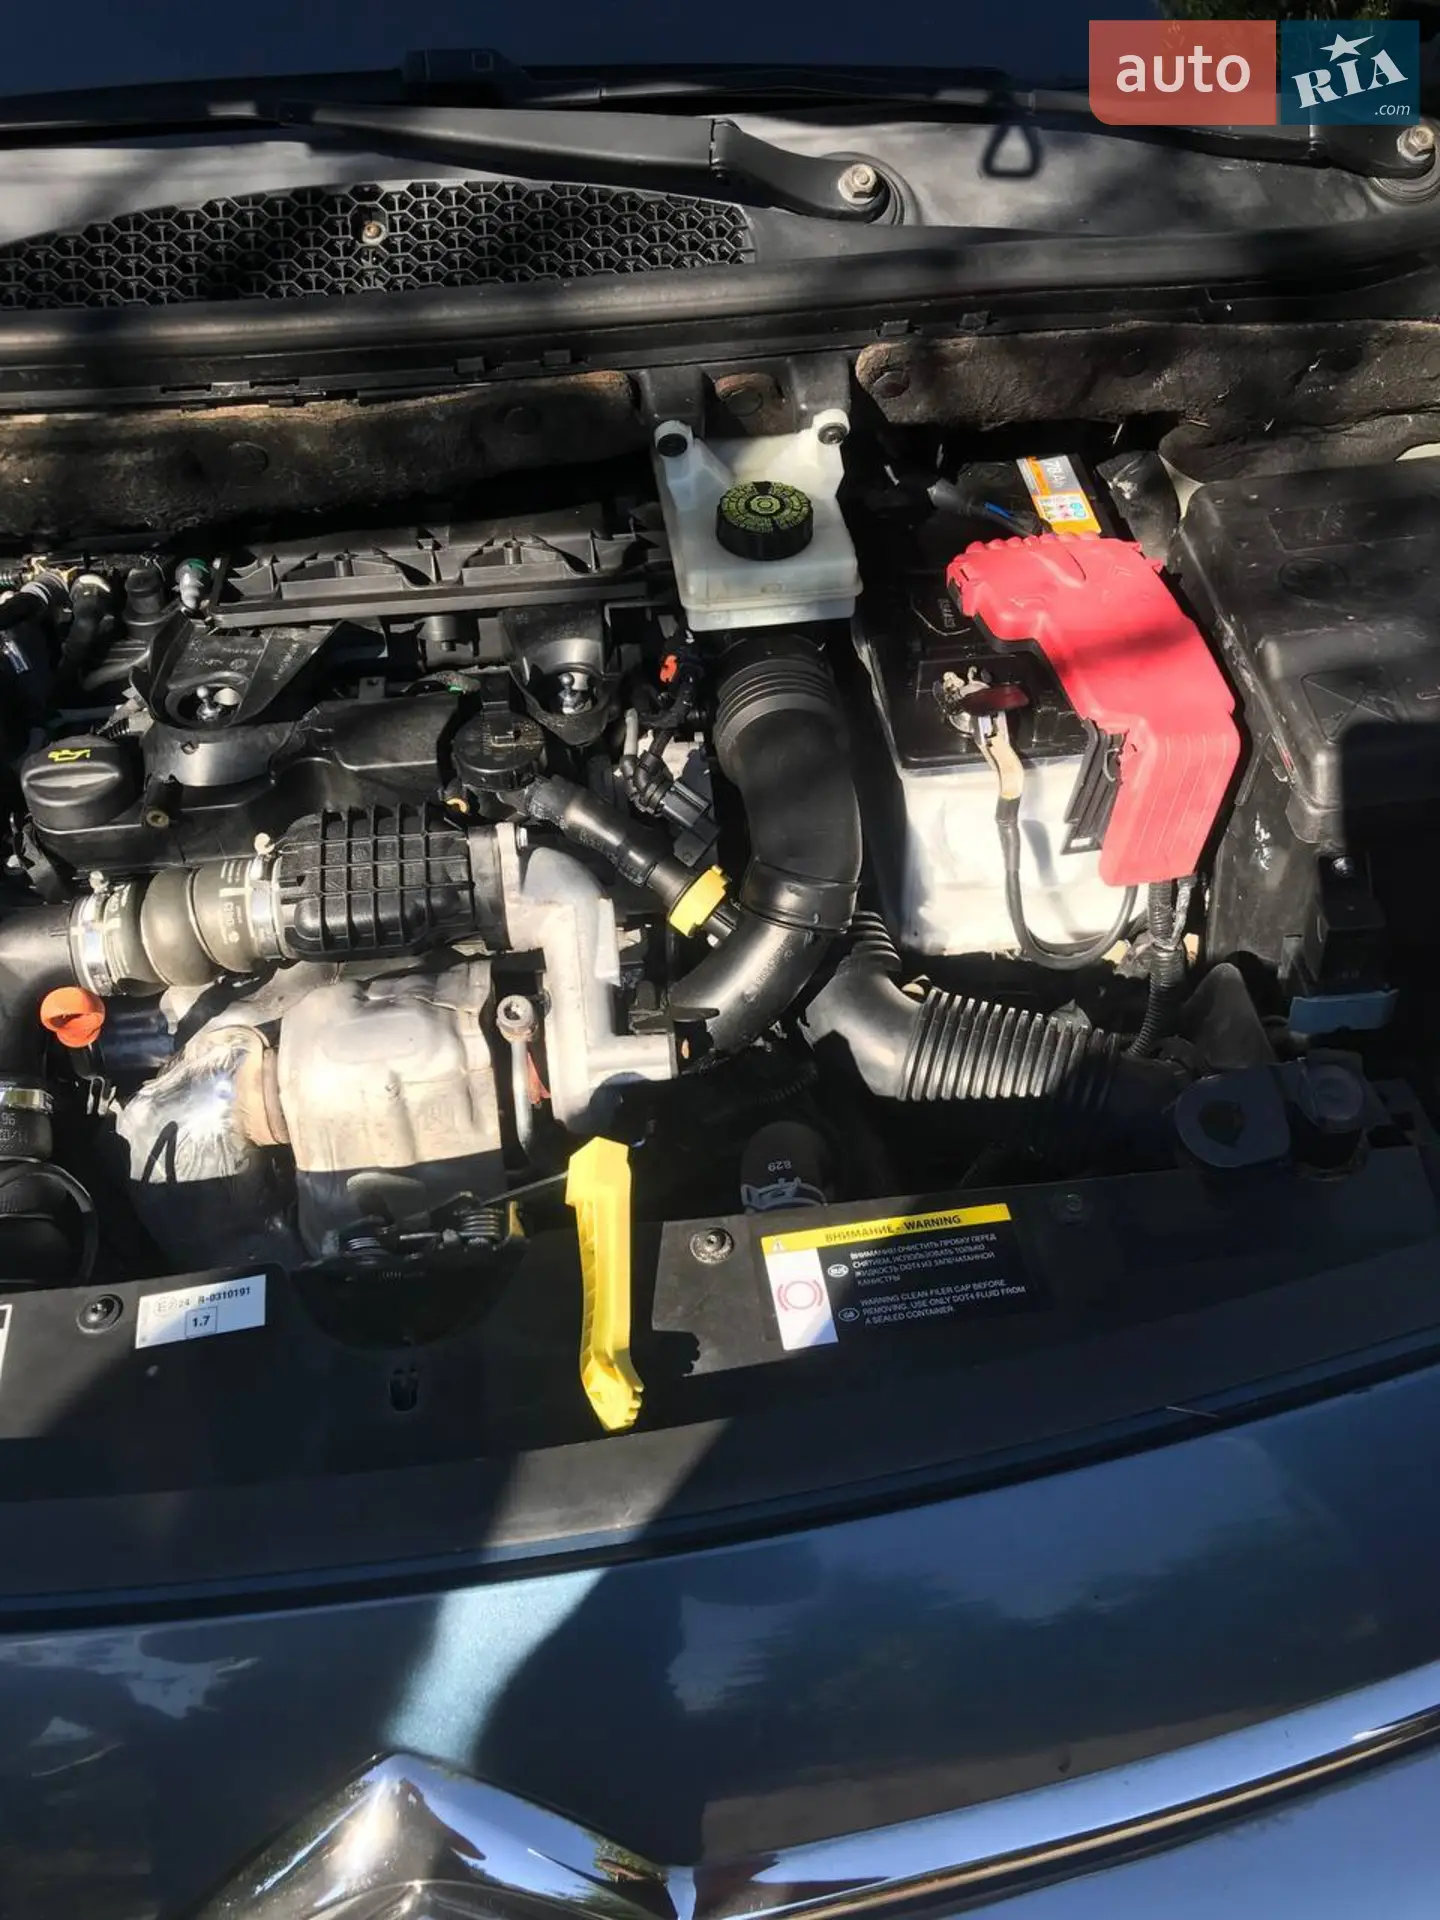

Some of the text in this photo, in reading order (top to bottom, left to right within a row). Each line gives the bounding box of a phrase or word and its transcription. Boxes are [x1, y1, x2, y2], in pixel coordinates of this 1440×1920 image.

[825, 1224, 894, 1242] ВНИМАНИЕ
[904, 1214, 961, 1230] WARNING
[192, 1315, 211, 1327] 1.7
